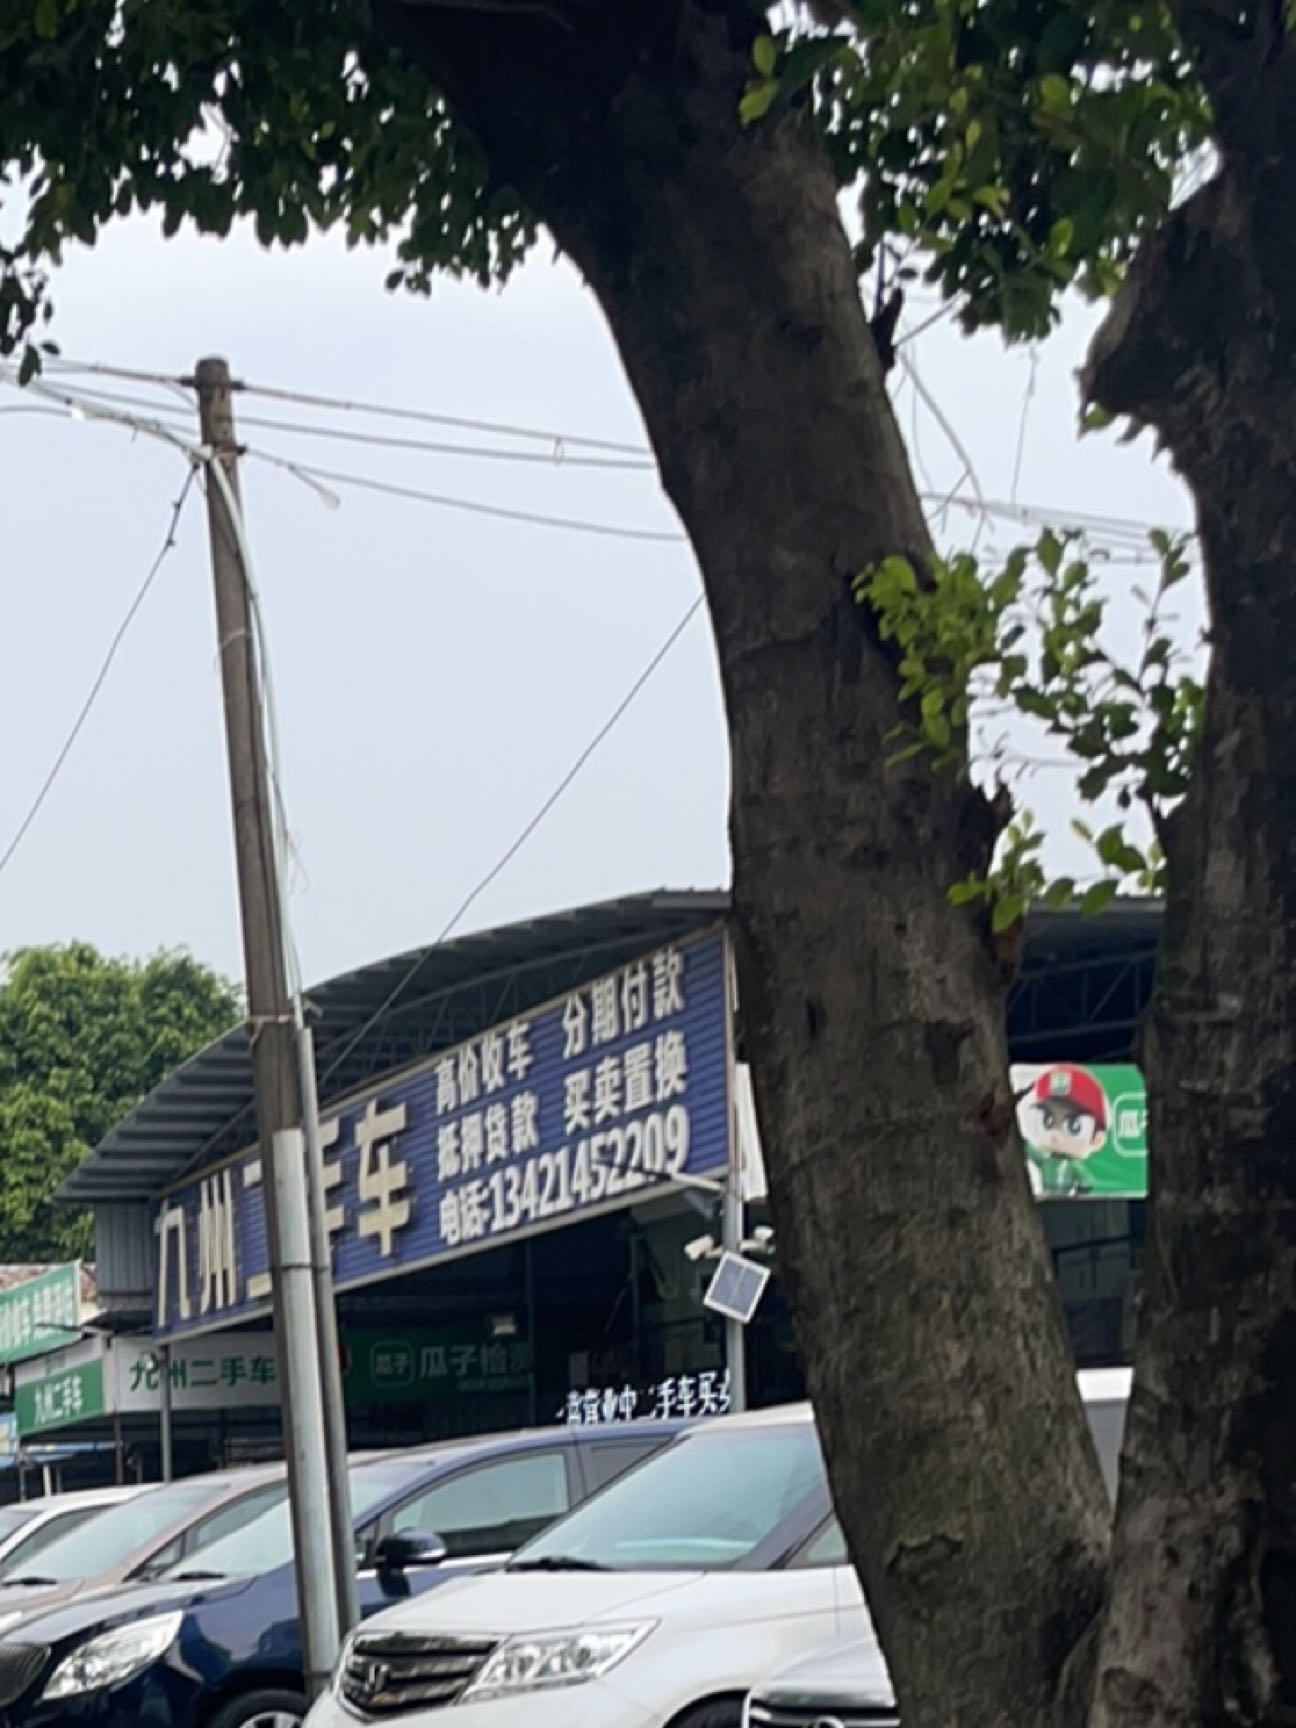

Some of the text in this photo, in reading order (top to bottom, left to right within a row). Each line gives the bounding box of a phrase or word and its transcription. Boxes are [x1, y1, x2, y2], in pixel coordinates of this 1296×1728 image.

[435, 945, 685, 1115] 高价收车 分期付款
[437, 1030, 687, 1182] 抵押贷款 买卖置换
